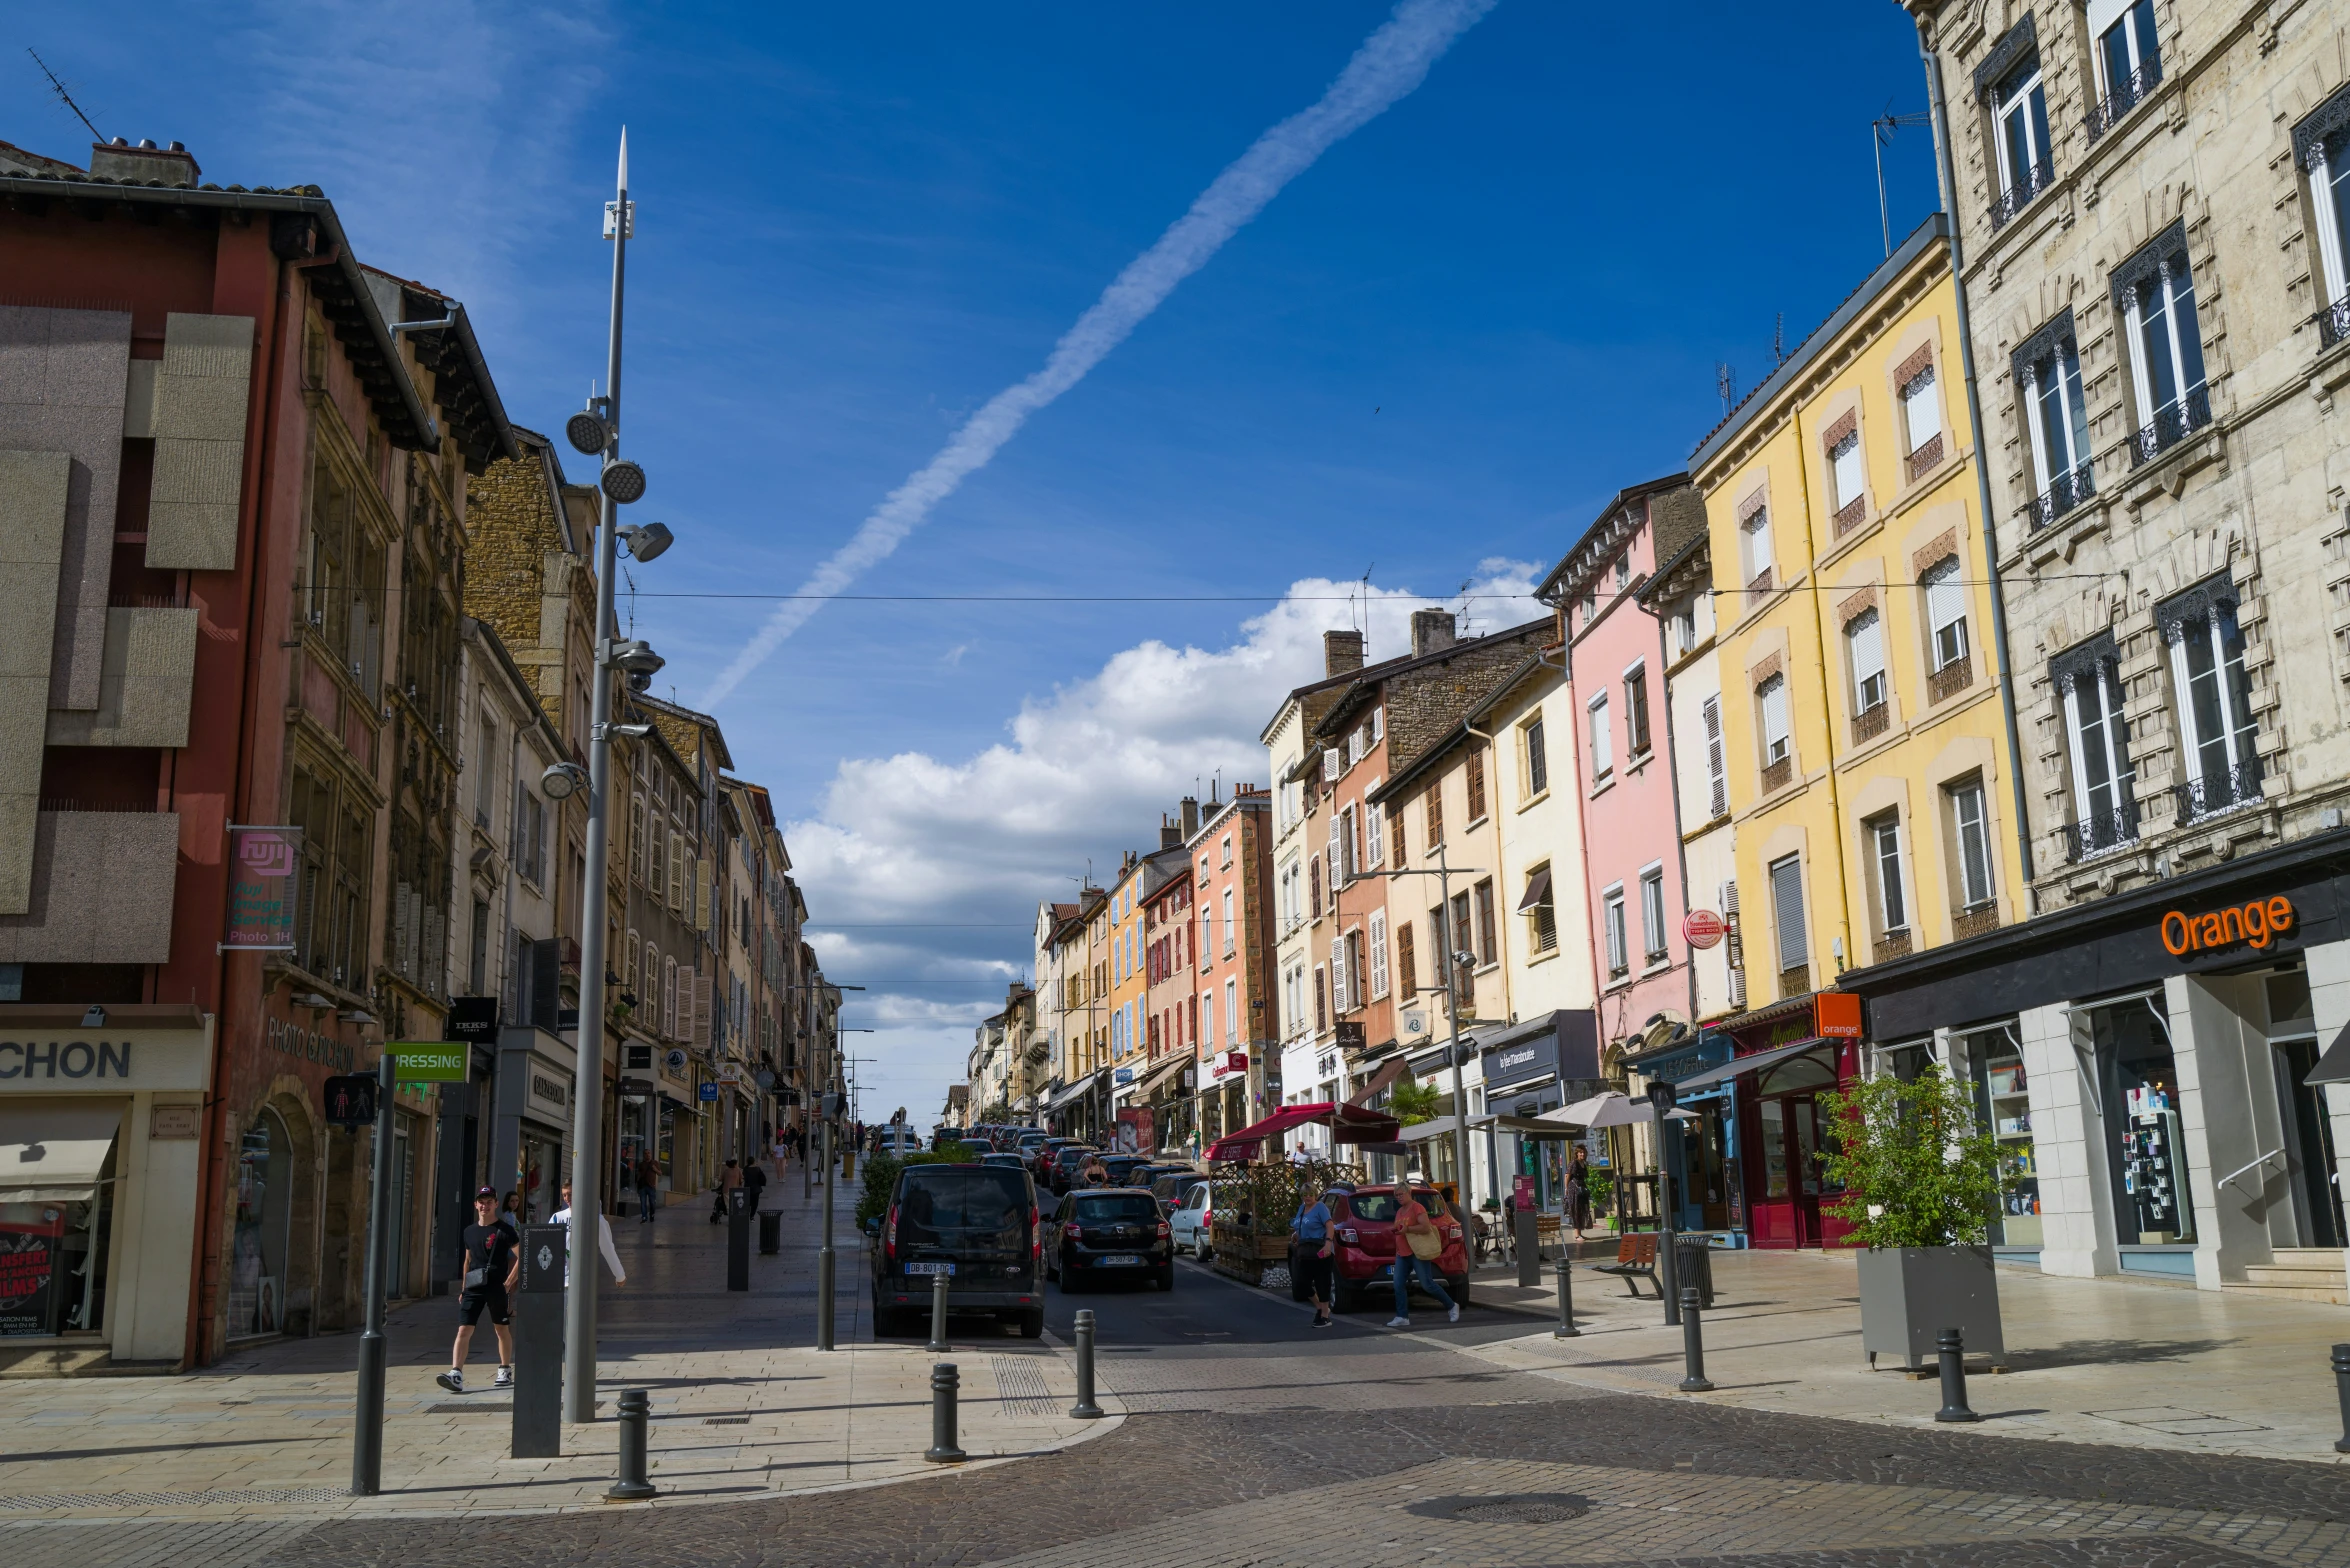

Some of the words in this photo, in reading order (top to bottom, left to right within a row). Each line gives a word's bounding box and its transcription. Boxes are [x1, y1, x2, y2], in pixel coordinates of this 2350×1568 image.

[235, 882, 264, 897] Fuji
[233, 898, 281, 913] Image
[232, 913, 292, 926] Service
[2161, 896, 2293, 955] Orange
[231, 931, 268, 942] Photo
[276, 932, 290, 942] 1H
[267, 1016, 304, 1058] PHOTO
[1824, 1025, 1857, 1035] orange
[0, 1041, 131, 1079] CHON
[0, 1250, 48, 1269] NSFERT
[11, 1264, 51, 1278] ANCIENS
